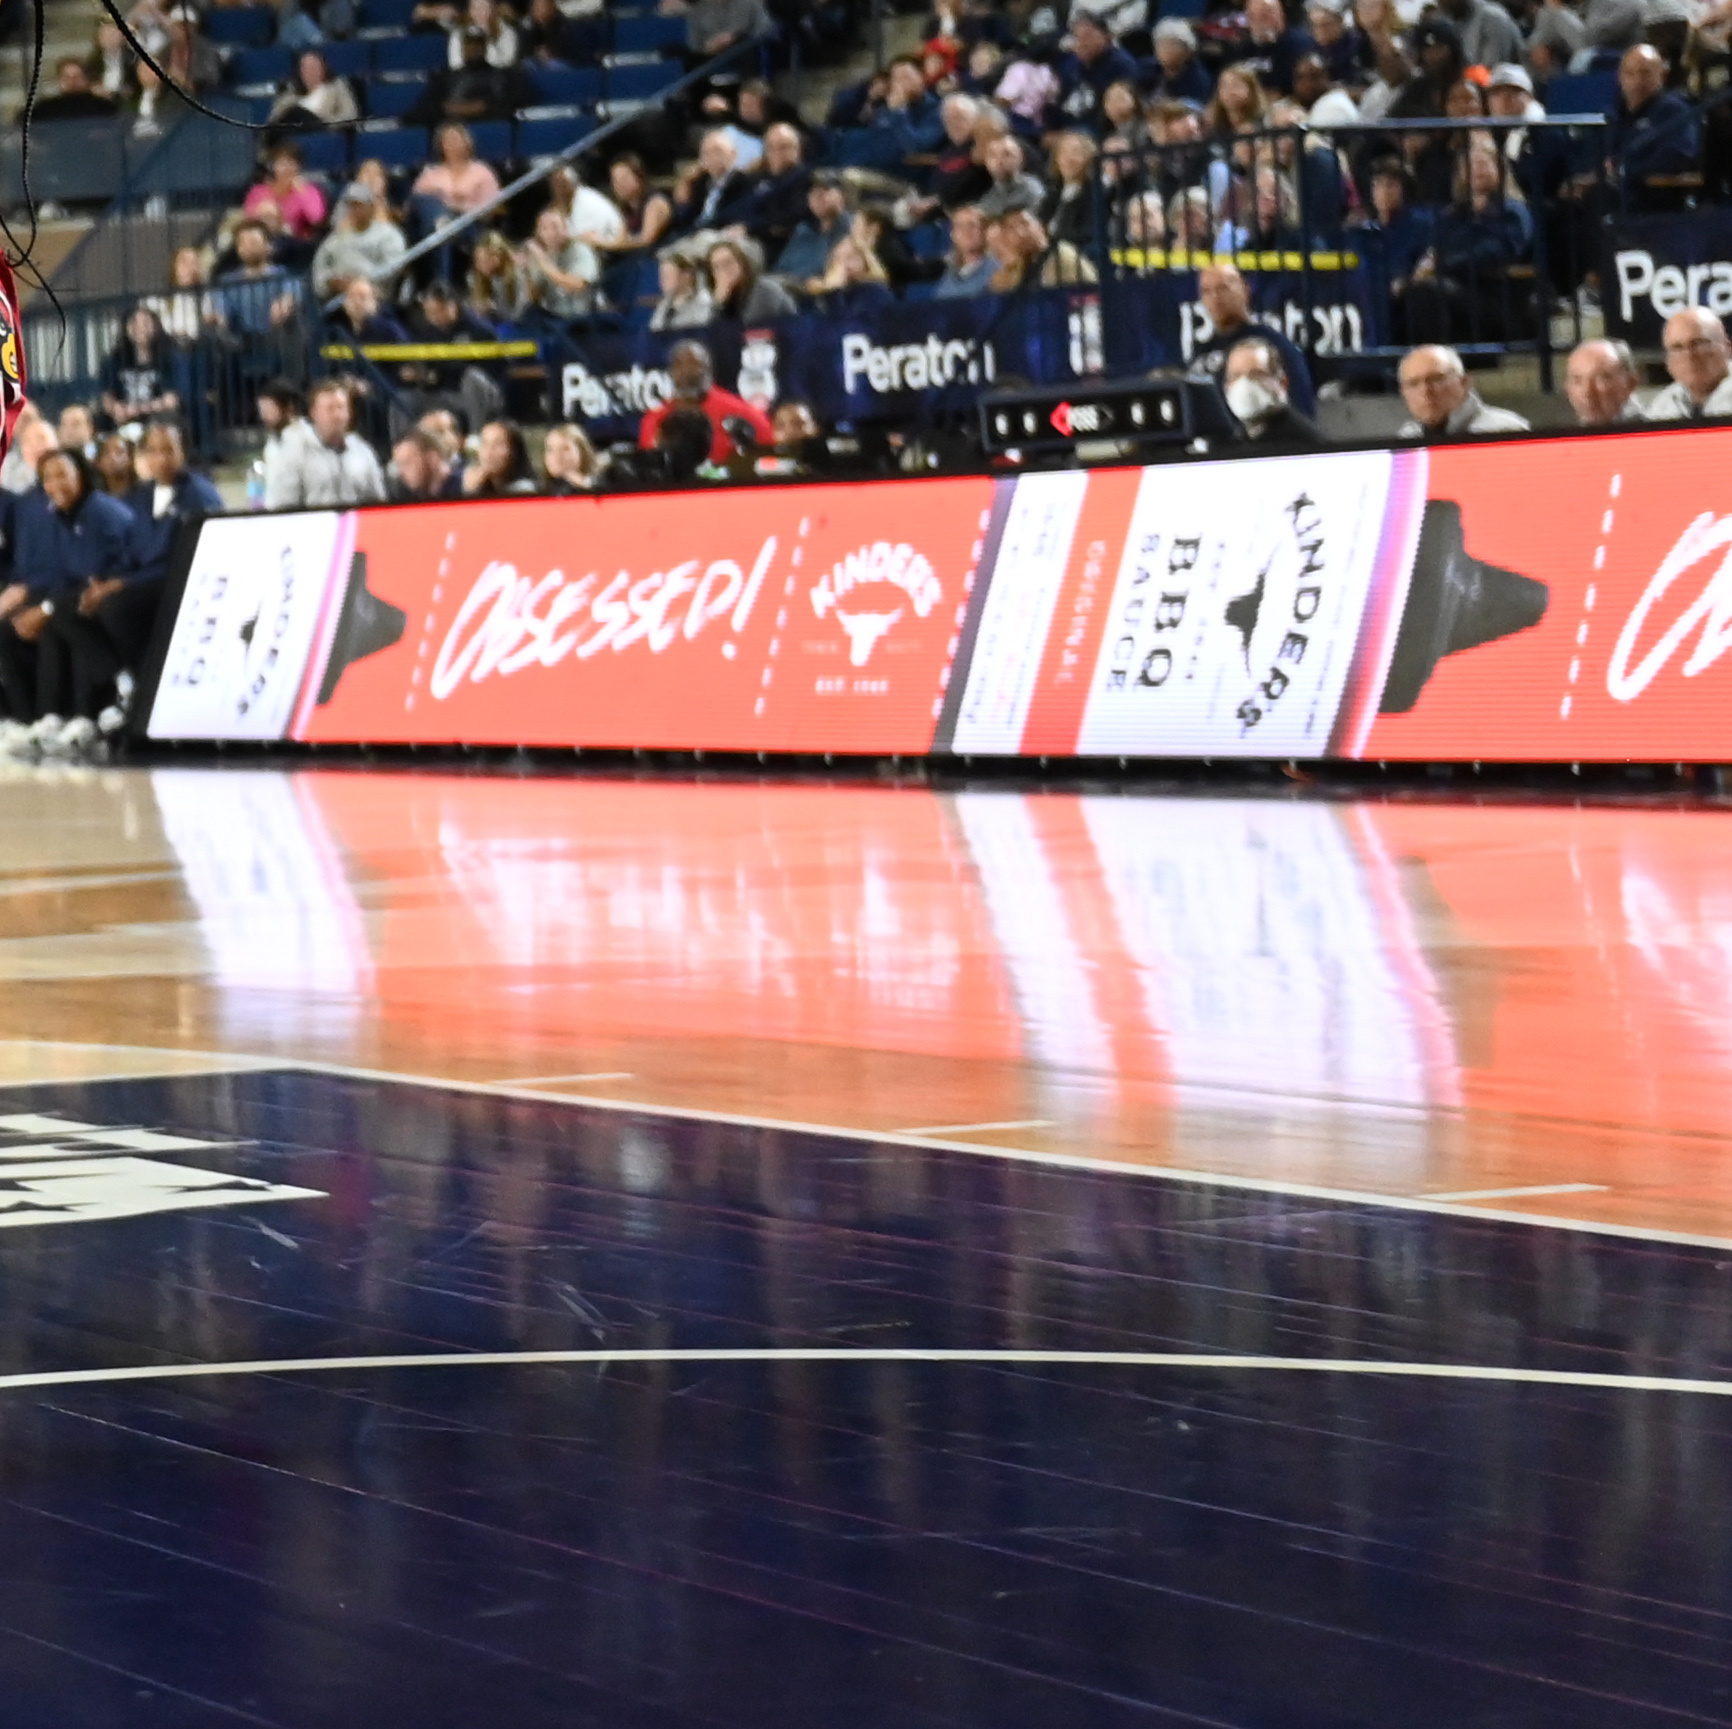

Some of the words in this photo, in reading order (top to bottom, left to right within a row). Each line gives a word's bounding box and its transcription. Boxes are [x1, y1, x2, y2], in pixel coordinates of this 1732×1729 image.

[429, 534, 778, 701] OBSESSED!
[1107, 533, 1160, 692] SAUCE
[1138, 536, 1201, 688] BBQ
